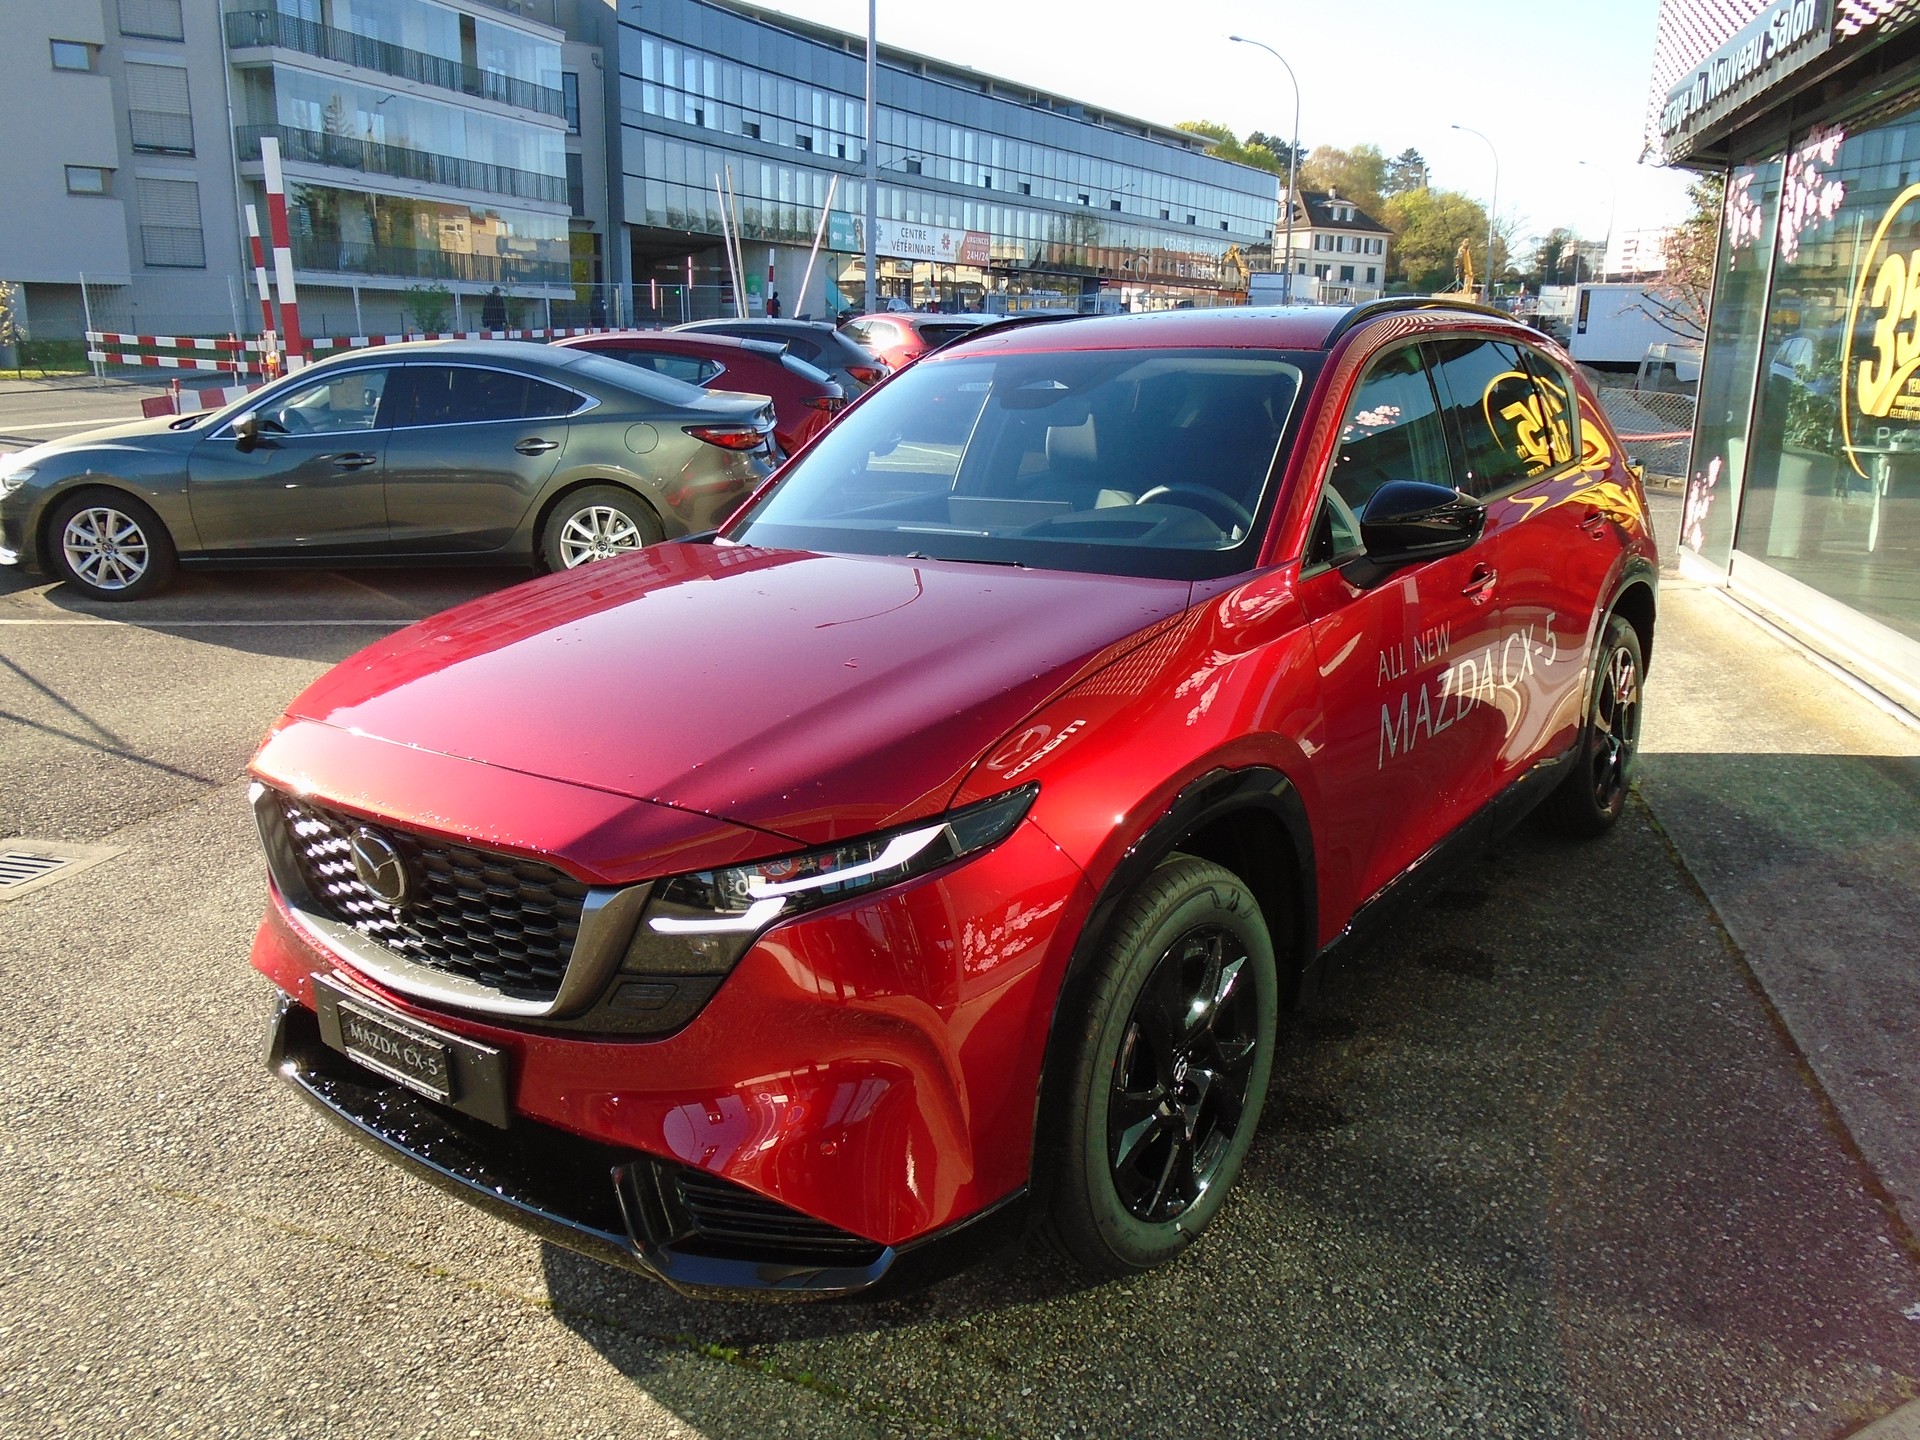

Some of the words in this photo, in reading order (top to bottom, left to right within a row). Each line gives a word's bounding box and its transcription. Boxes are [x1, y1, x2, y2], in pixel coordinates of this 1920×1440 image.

[1690, 72, 1705, 113] du
[1707, 36, 1764, 100] Nouveau
[1766, 0, 1815, 59] Salon
[891, 238, 936, 256] VÉTÉRINAIRE
[900, 228, 927, 240] CENTRE
[1378, 643, 1407, 687] ALL
[1413, 620, 1450, 668] NEW
[1378, 648, 1495, 770] MAZDA
[1502, 612, 1557, 688] CX-5
[350, 1023, 400, 1059] MAZDA
[404, 1048, 437, 1075] CX-5
